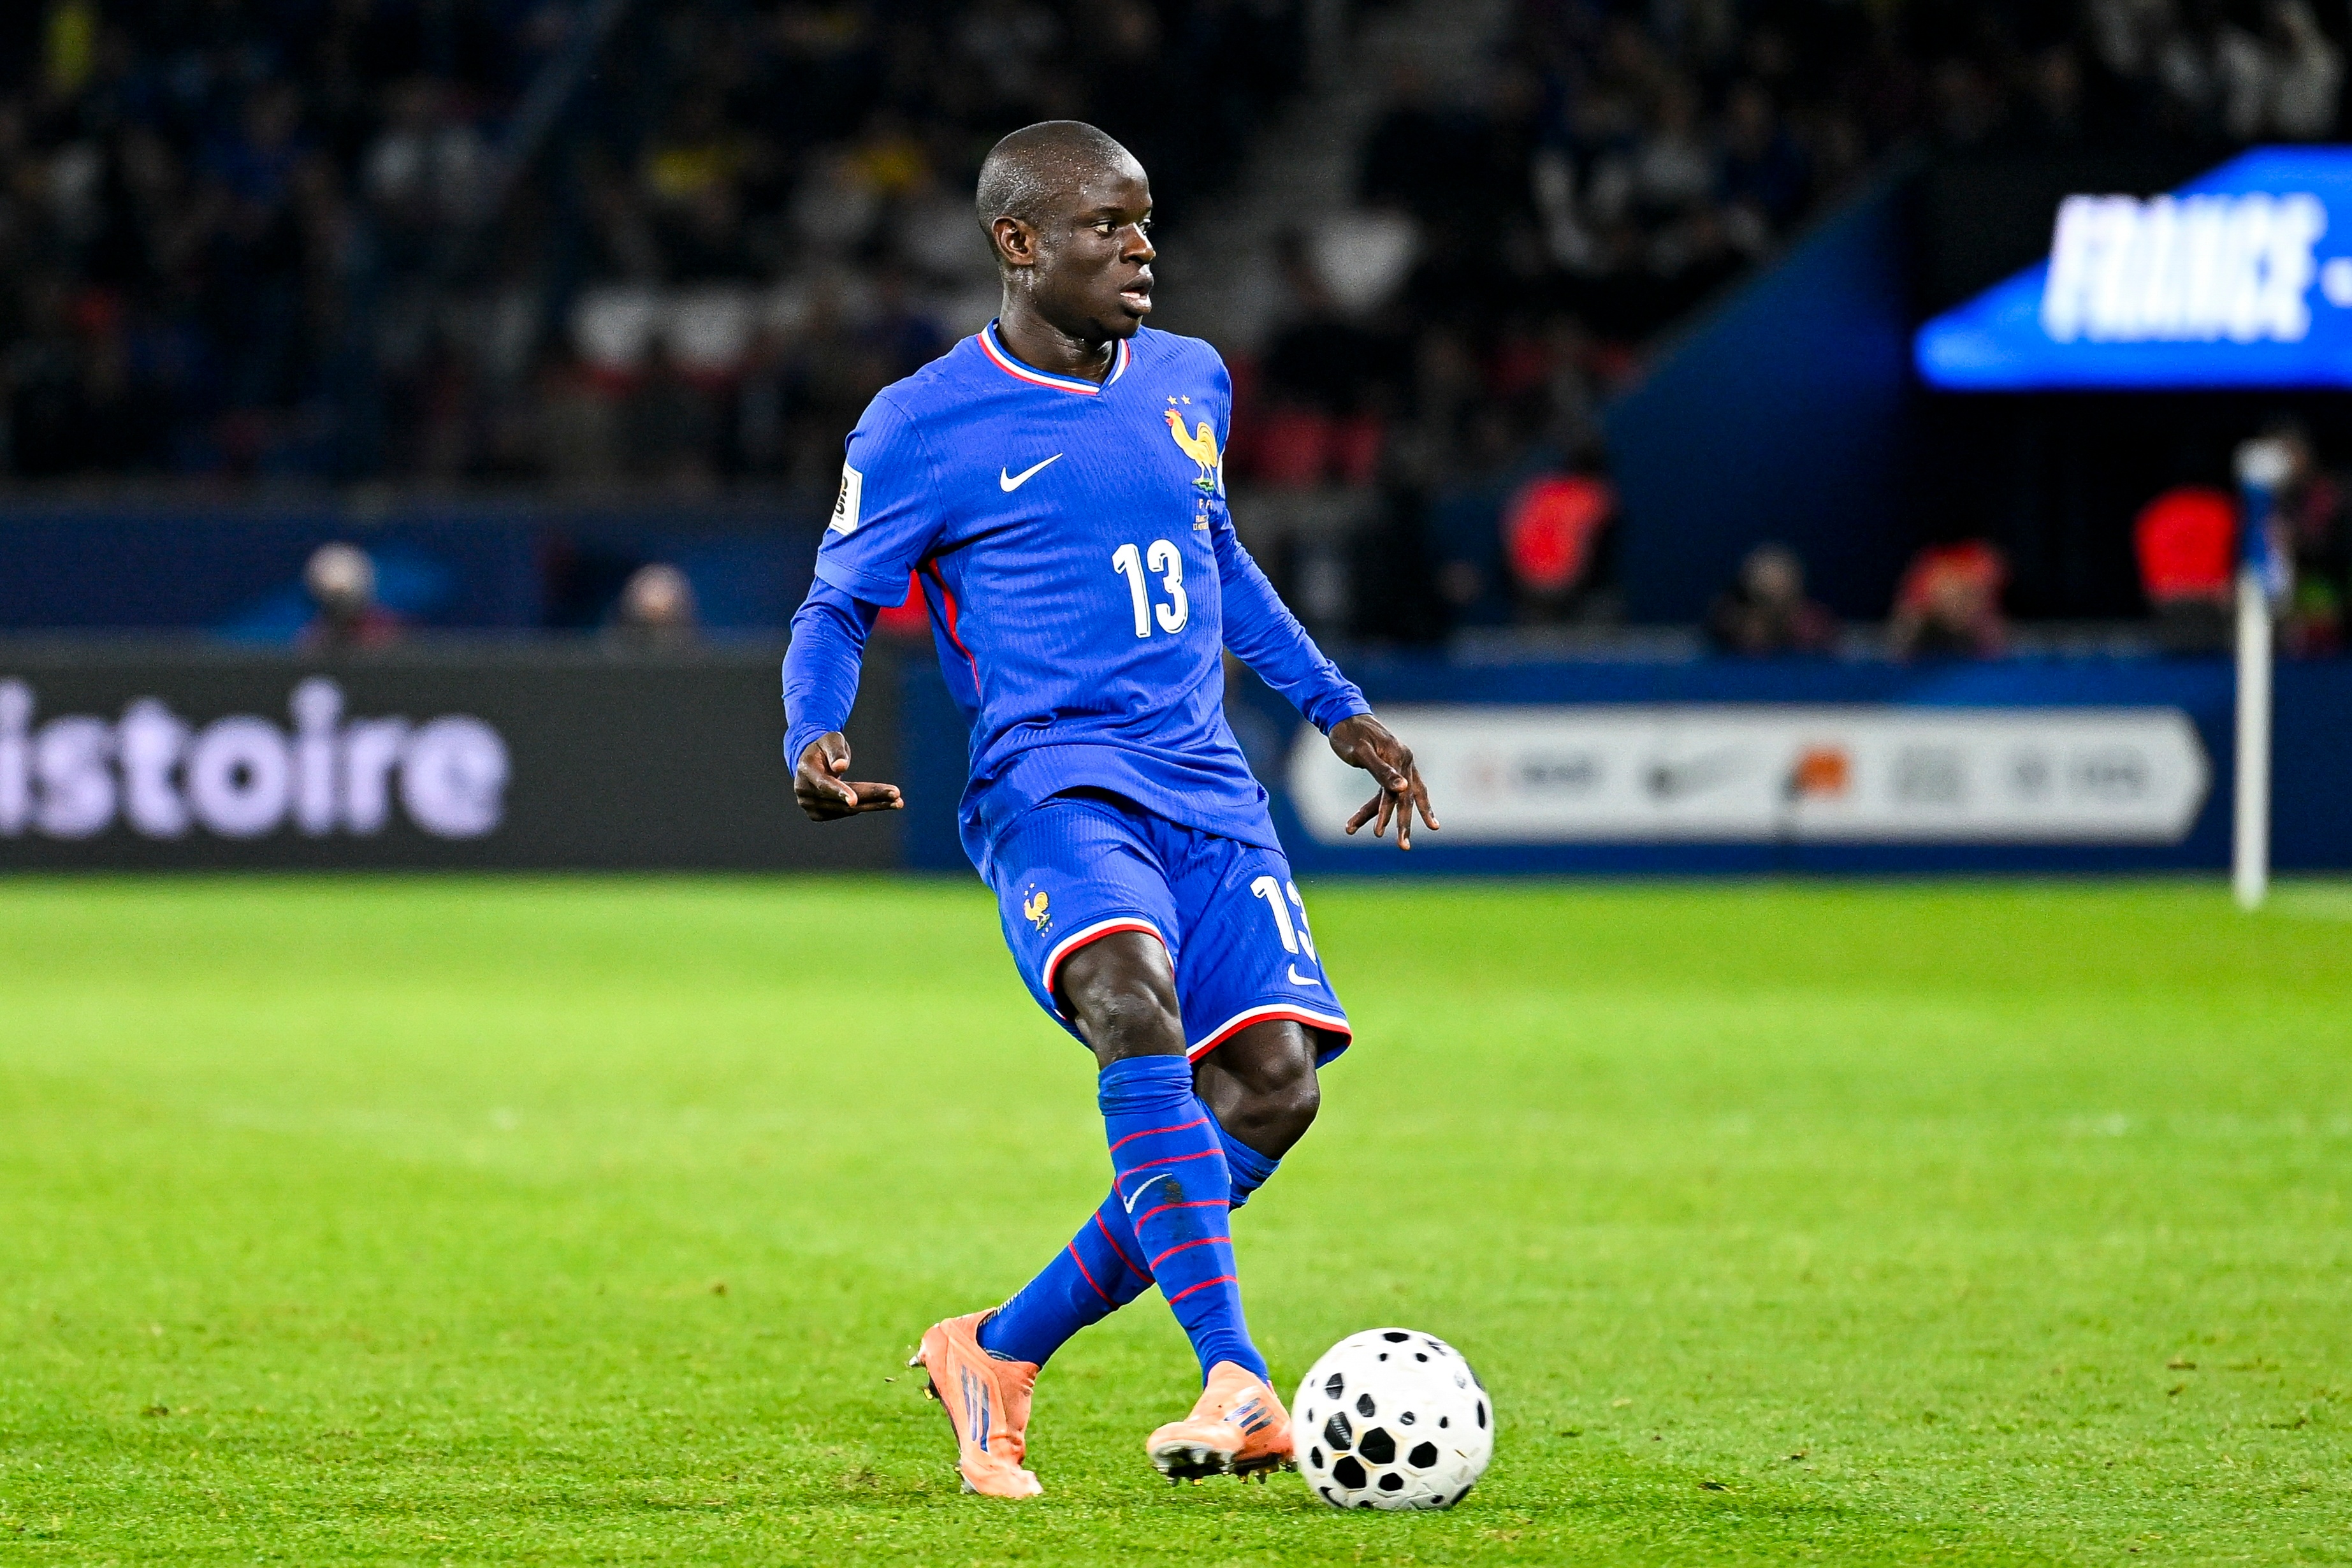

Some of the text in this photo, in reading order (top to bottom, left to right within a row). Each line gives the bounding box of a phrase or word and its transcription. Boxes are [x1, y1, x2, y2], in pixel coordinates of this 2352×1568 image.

[2043, 194, 2327, 342] FRANCE
[1112, 539, 1188, 638] 13
[0, 677, 509, 838] istoire
[1249, 875, 1318, 966] 13
